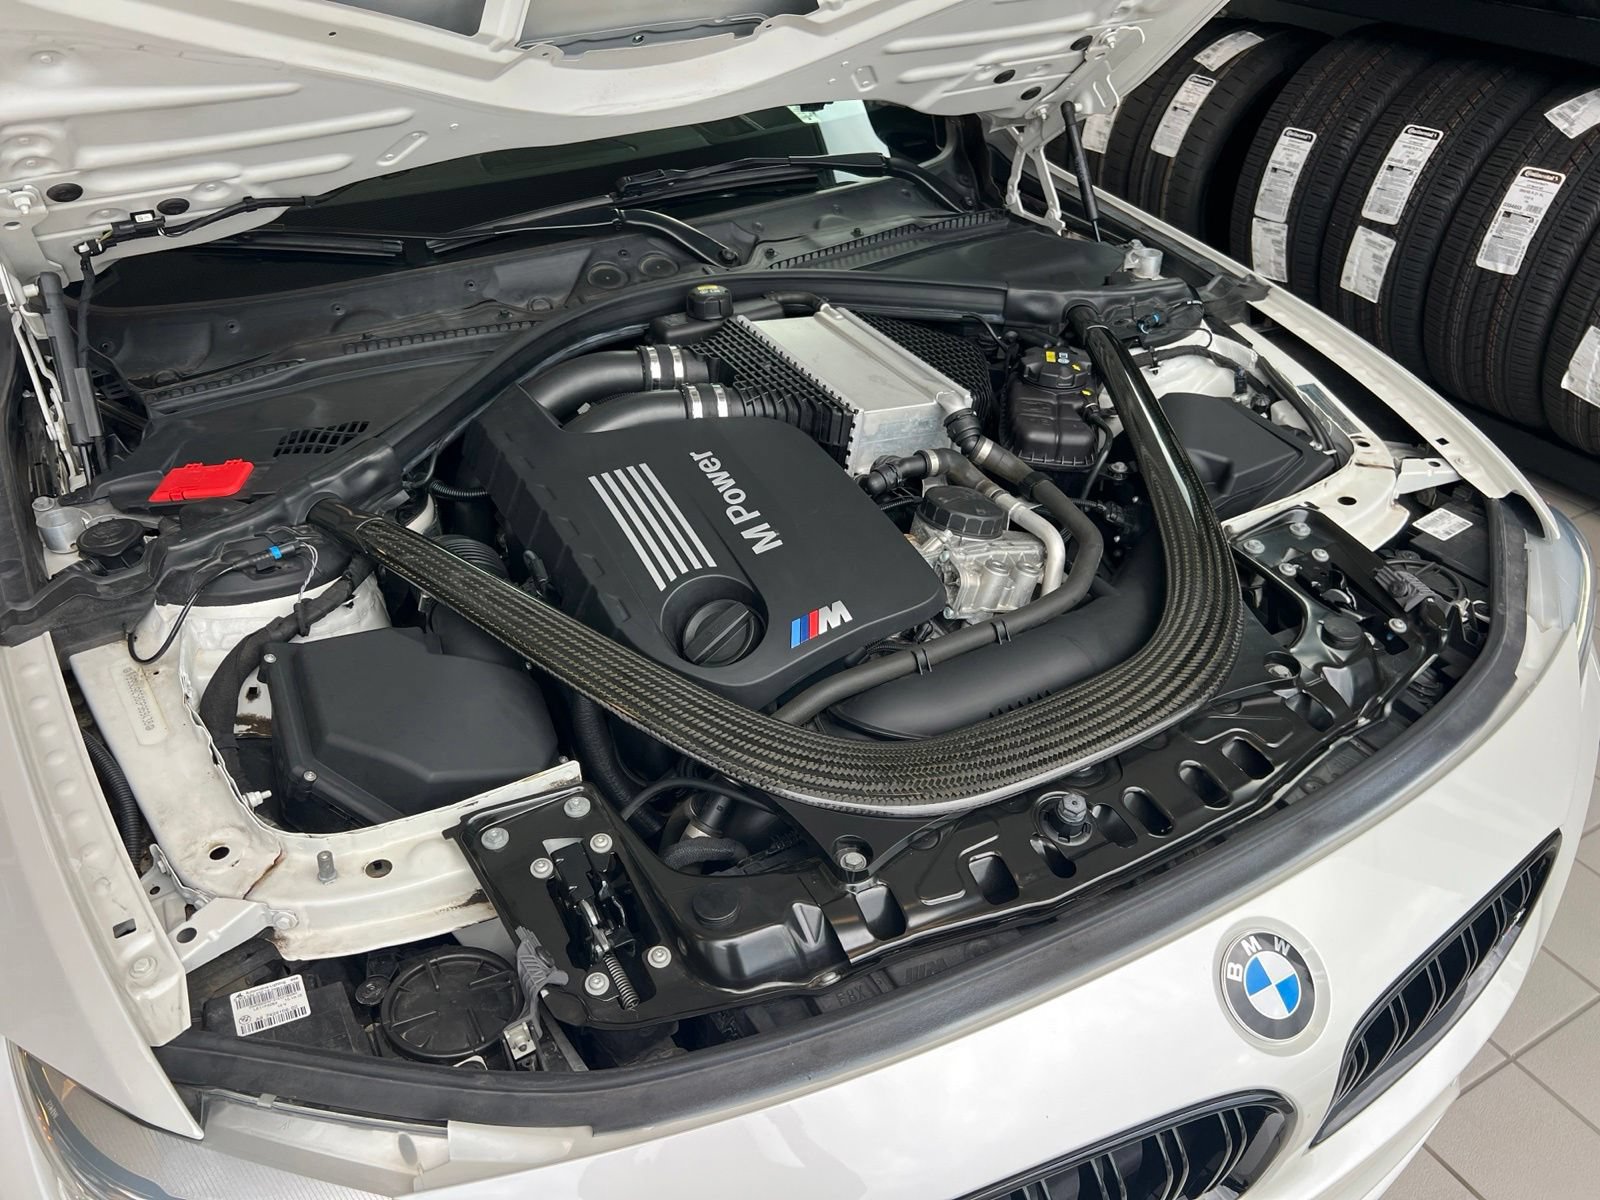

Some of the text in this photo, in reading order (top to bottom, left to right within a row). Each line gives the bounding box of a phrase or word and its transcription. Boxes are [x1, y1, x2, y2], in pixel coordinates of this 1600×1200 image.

[689, 450, 783, 555] M Power
[1227, 935, 1290, 982] BMW
